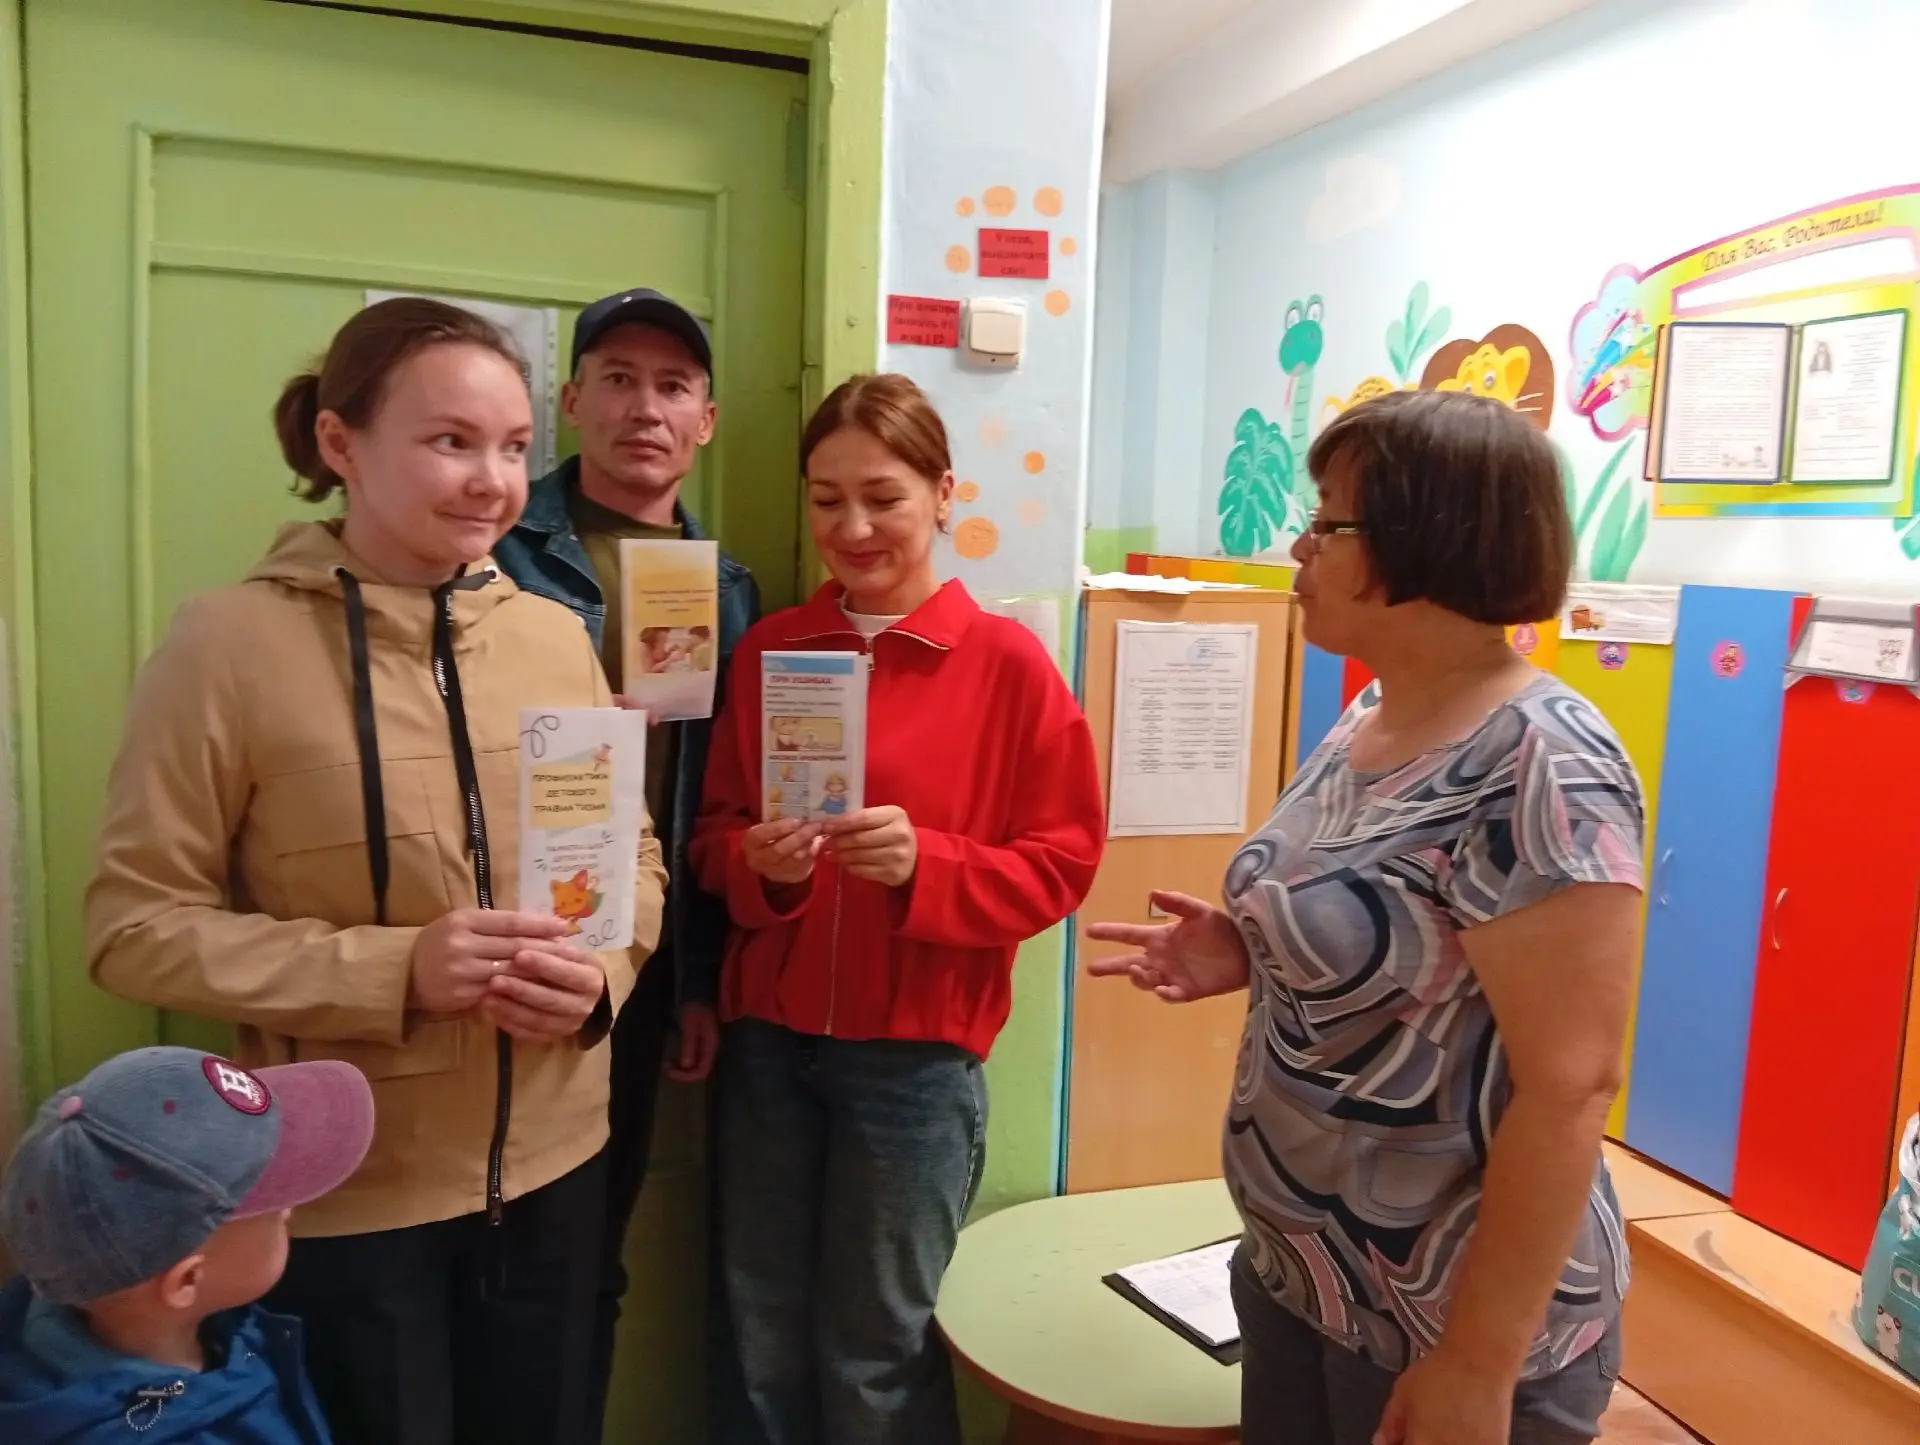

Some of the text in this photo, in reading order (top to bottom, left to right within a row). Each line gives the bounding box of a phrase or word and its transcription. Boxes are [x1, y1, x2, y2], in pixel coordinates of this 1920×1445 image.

[1701, 250, 1738, 272] Для
[533, 773, 608, 782] ПРОФИЛАКТИКА
[546, 788, 597, 797] ДЕТСКОГО
[533, 803, 606, 812] ТРАВМАТИЗМА
